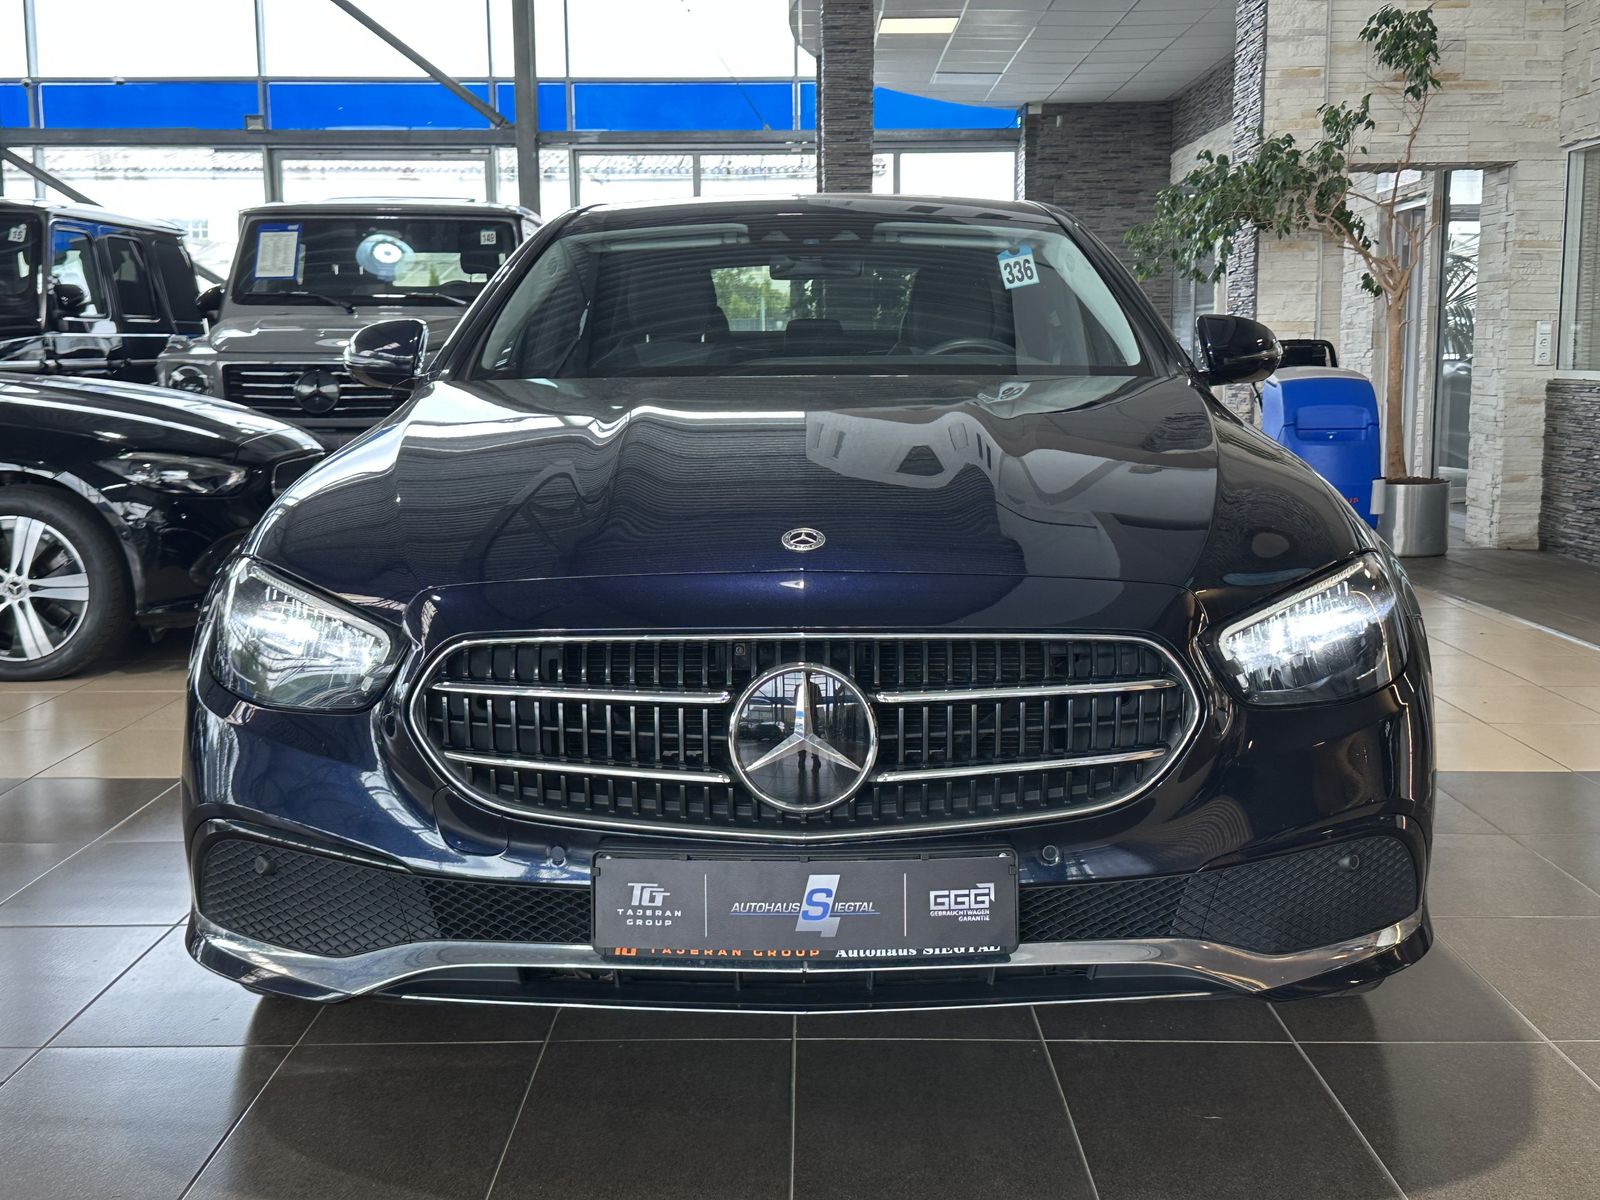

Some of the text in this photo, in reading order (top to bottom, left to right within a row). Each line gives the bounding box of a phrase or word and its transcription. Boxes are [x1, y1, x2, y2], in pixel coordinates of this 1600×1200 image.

[1003, 258, 1034, 284] 336
[930, 888, 990, 910] GGG
[730, 902, 801, 913] AUTOHAUS
[617, 908, 682, 917] TAJERAN
[930, 909, 990, 917] GEBRAUCHTWAGEN
[626, 918, 672, 926] GROUP
[752, 949, 820, 957] GROUP
